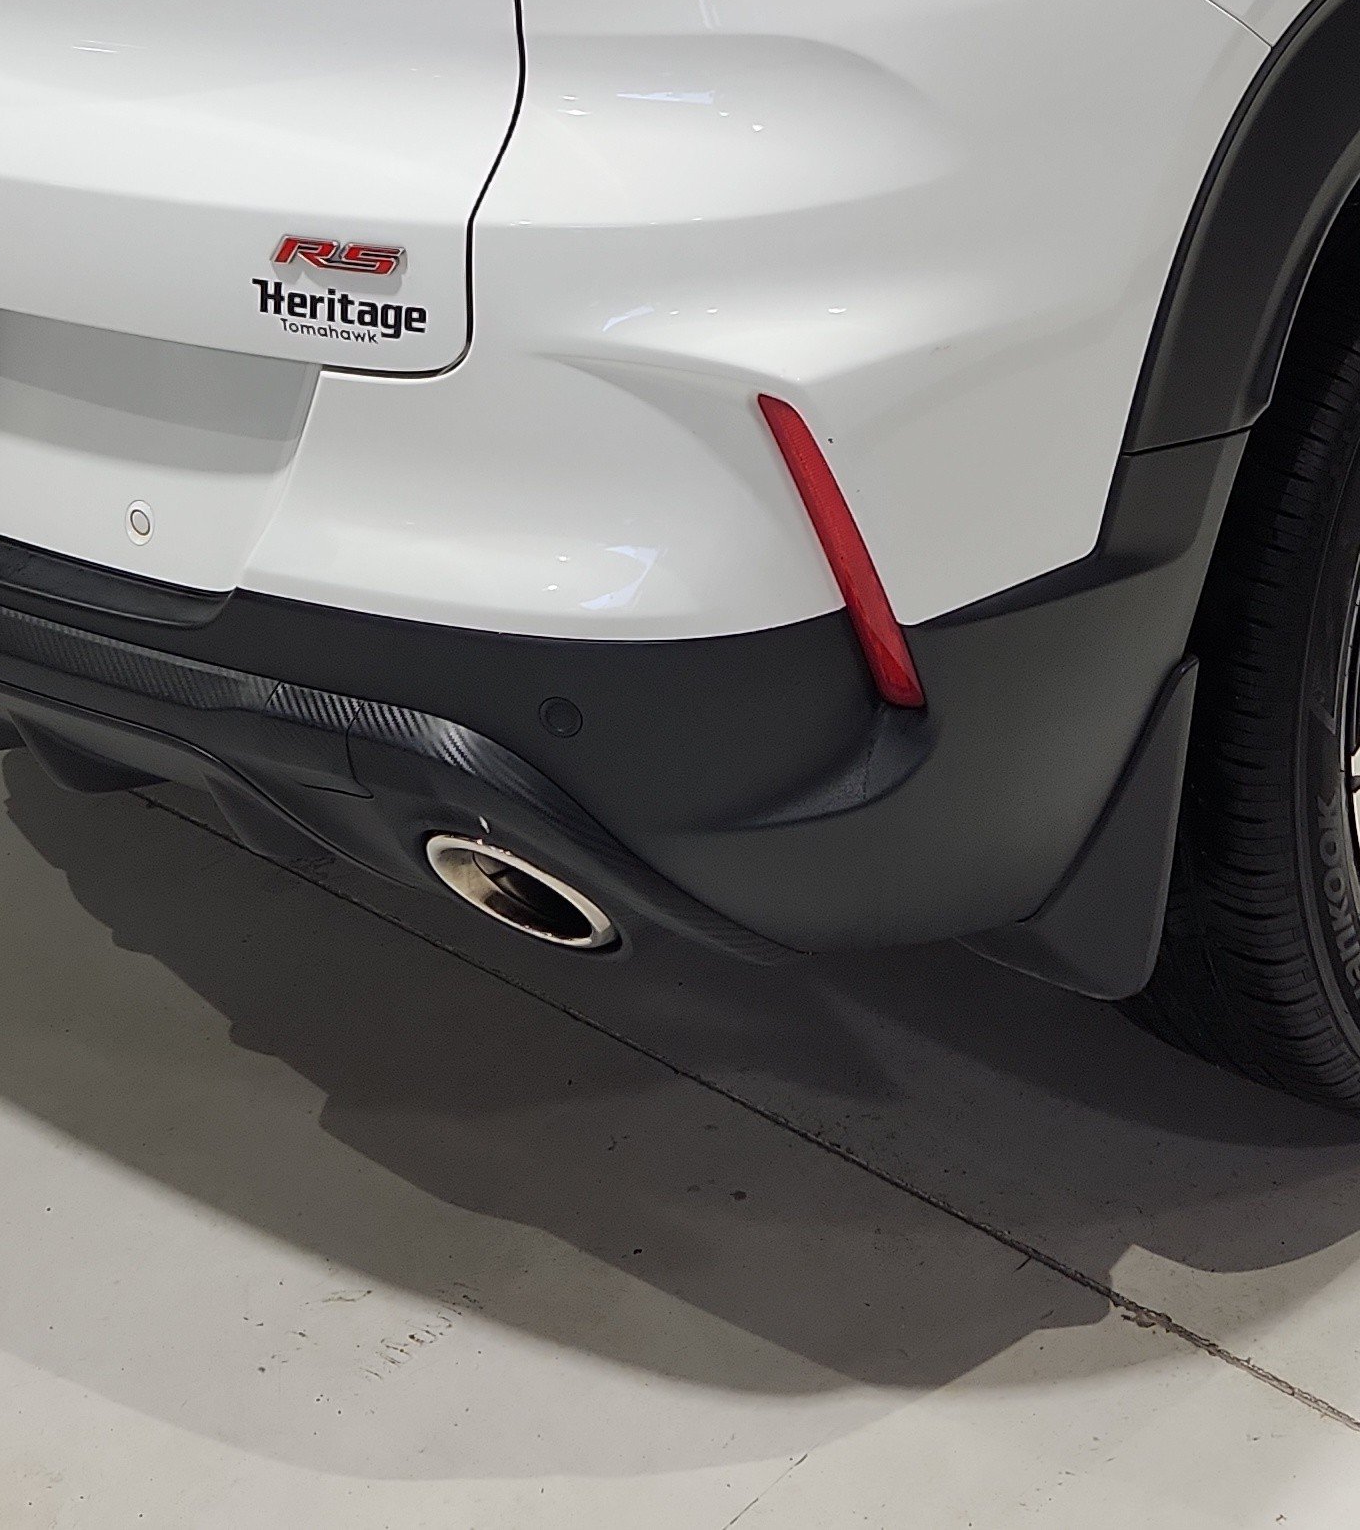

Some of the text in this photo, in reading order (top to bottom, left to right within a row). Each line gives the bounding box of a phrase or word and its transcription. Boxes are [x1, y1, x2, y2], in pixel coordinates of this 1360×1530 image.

[269, 234, 408, 276] RS
[252, 278, 427, 339] Heritage
[280, 318, 379, 344] Tomahawk
